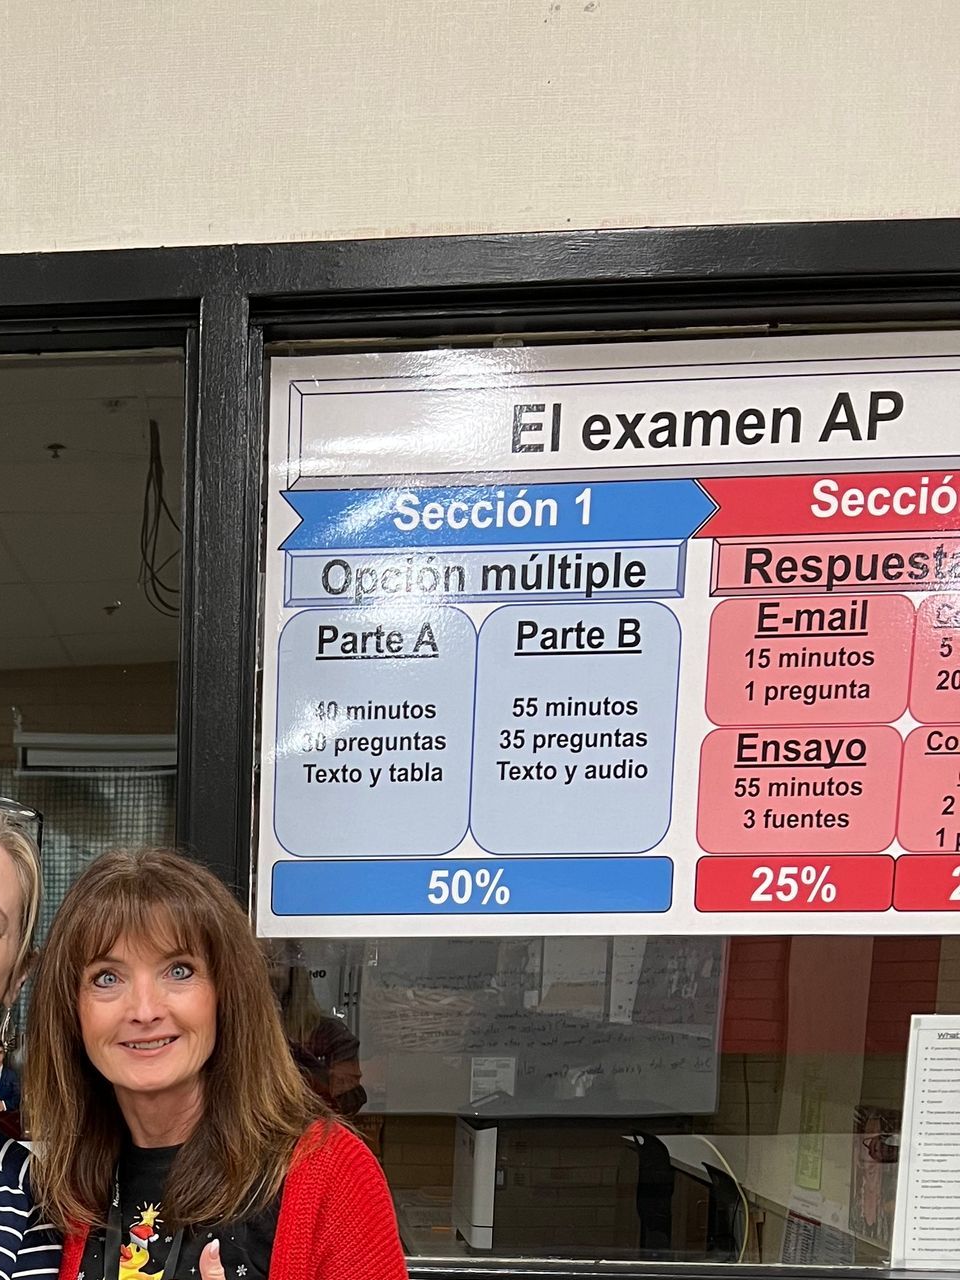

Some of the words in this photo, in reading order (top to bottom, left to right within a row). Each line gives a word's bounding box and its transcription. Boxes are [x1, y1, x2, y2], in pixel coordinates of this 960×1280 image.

[511, 402, 562, 454] El
[581, 403, 802, 452] examen
[819, 390, 906, 442] AP
[392, 488, 558, 532] Sección
[575, 487, 592, 526] 1
[810, 475, 959, 519] Secció
[320, 554, 466, 605] Opción
[481, 551, 648, 598] múltiple
[757, 599, 869, 633] E-mail
[317, 624, 404, 655] Parte
[412, 621, 439, 653] A
[516, 619, 606, 650] Parte
[617, 617, 642, 649] B
[744, 648, 771, 669] 15
[778, 647, 876, 668] minutos
[512, 697, 539, 718] 55
[545, 696, 639, 718] minutos
[744, 680, 755, 701] 1
[764, 679, 871, 706] pregunta
[346, 700, 437, 720] minutos
[334, 731, 447, 757] preguntas
[499, 729, 526, 750] 35
[533, 727, 649, 754] preguntas
[736, 732, 867, 769] Ensayo
[302, 763, 362, 784] Texto
[369, 766, 382, 788] y
[389, 762, 444, 783] tabla
[496, 760, 558, 781] Texto
[564, 764, 578, 785] y
[584, 758, 649, 780] audio
[734, 777, 761, 798] 55
[768, 776, 864, 797] minutos
[743, 808, 756, 829] 3
[763, 808, 850, 829] fuentes
[427, 868, 511, 906] 50%
[750, 864, 837, 903] 25%
